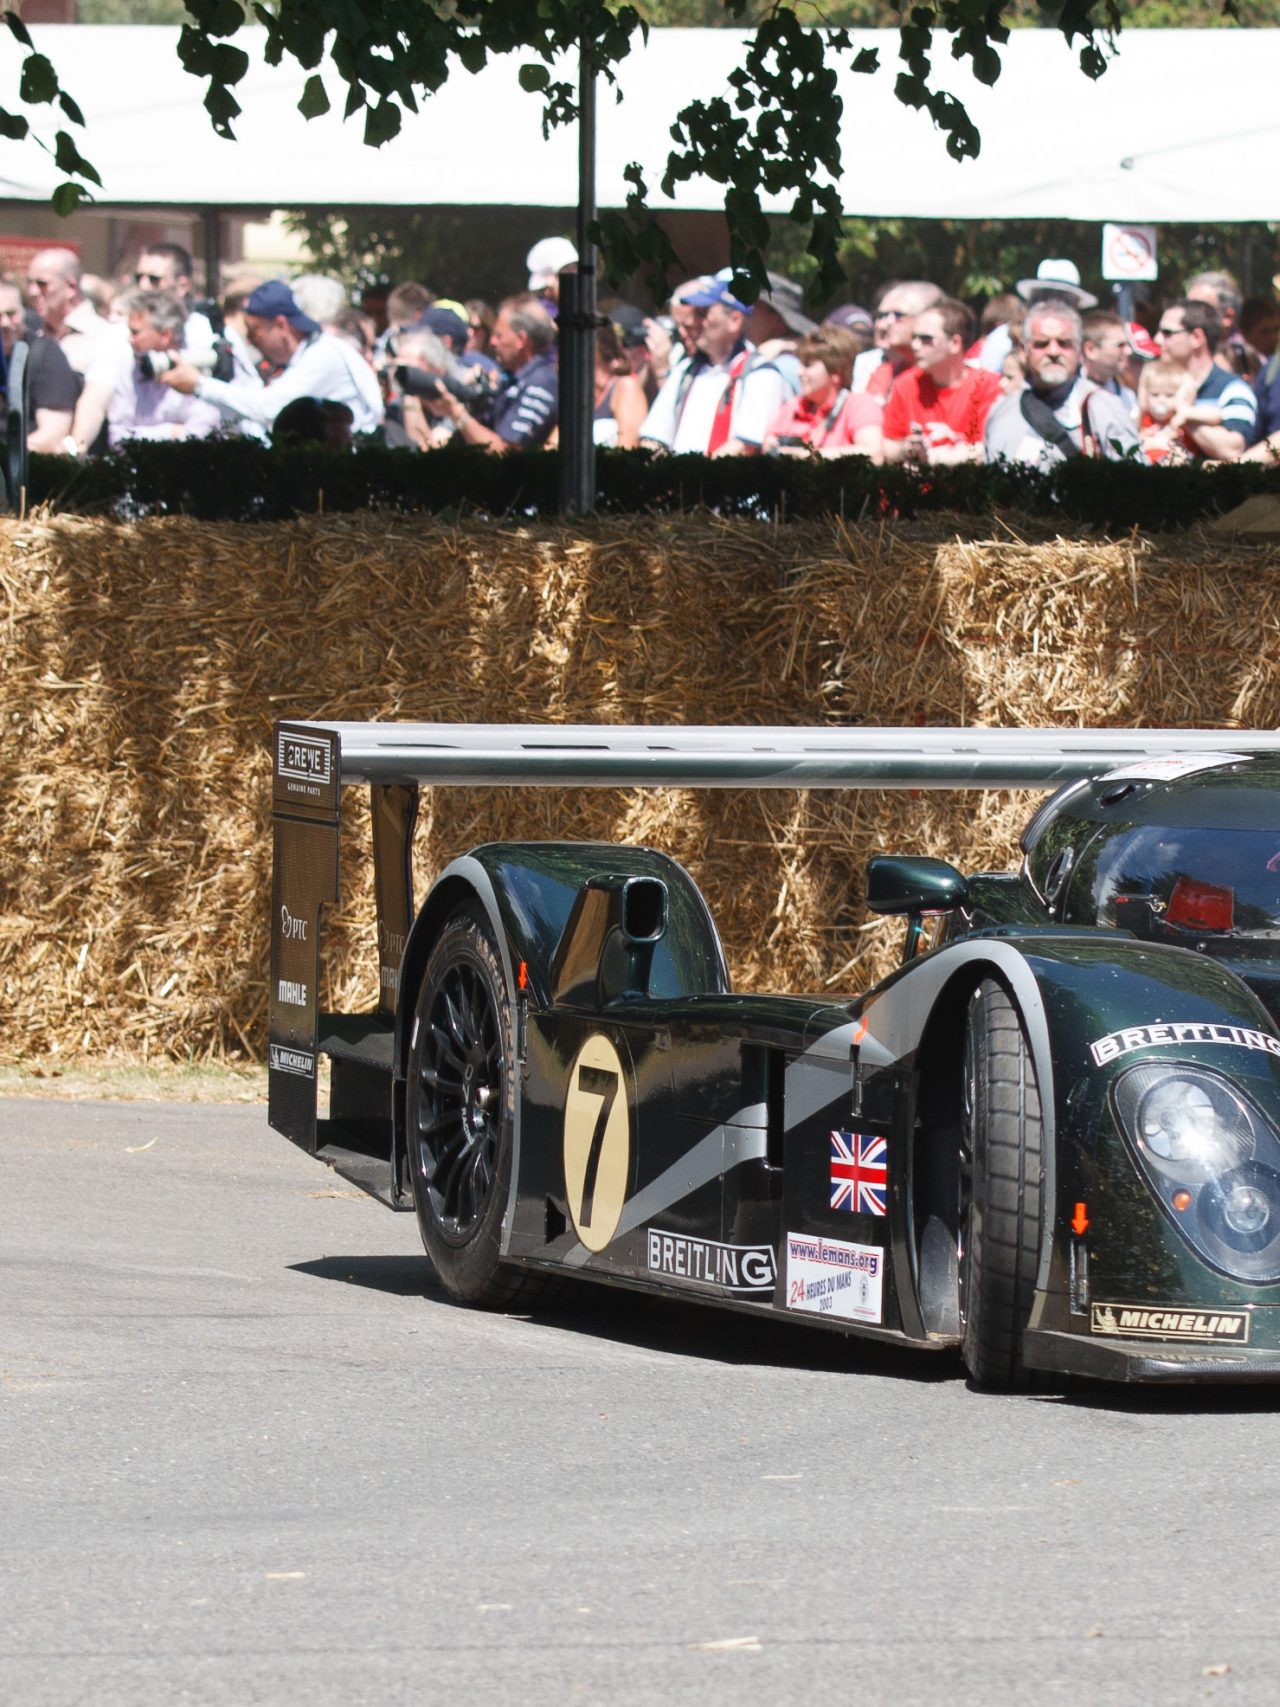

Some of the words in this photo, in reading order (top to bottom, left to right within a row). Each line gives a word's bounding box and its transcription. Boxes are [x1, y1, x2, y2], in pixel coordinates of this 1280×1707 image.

[288, 745, 321, 770] CREWE
[292, 918, 308, 942] PTC
[278, 979, 307, 1007] MAHLE
[280, 1050, 313, 1071] MICHELIN
[578, 1064, 619, 1229] 7
[650, 1234, 774, 1286] BREITLING
[789, 1239, 879, 1276] www.lemans.org
[790, 1278, 806, 1304] 24
[806, 1279, 827, 1301] HEURES
[827, 1276, 836, 1294] DU
[836, 1271, 852, 1291] MANS
[1119, 1310, 1242, 1334] MICHELIN
